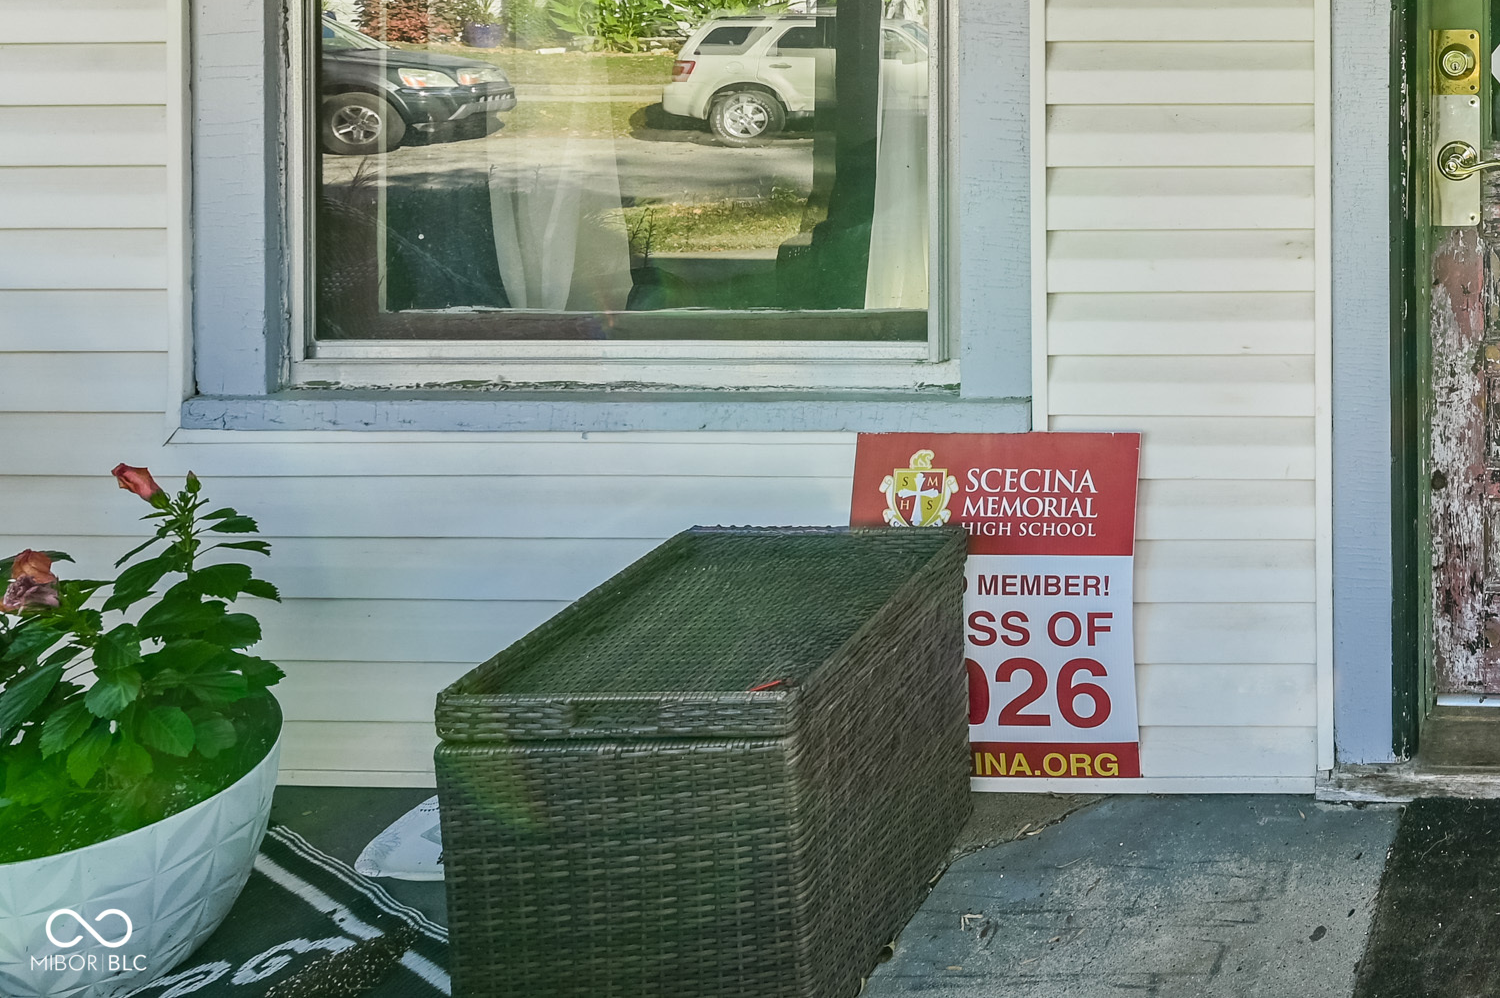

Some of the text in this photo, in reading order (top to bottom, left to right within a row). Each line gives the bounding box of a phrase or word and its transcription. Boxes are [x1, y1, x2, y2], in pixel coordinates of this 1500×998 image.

[927, 477, 938, 487] M
[964, 468, 1099, 494] SCECINA
[900, 500, 910, 510] H
[961, 496, 1099, 519] MEMORIAL
[961, 522, 1097, 538] HIGH SCHOOL
[977, 575, 1110, 597] MEMBER!
[1047, 611, 1113, 647] OF
[970, 753, 1119, 777] INA.ORG
